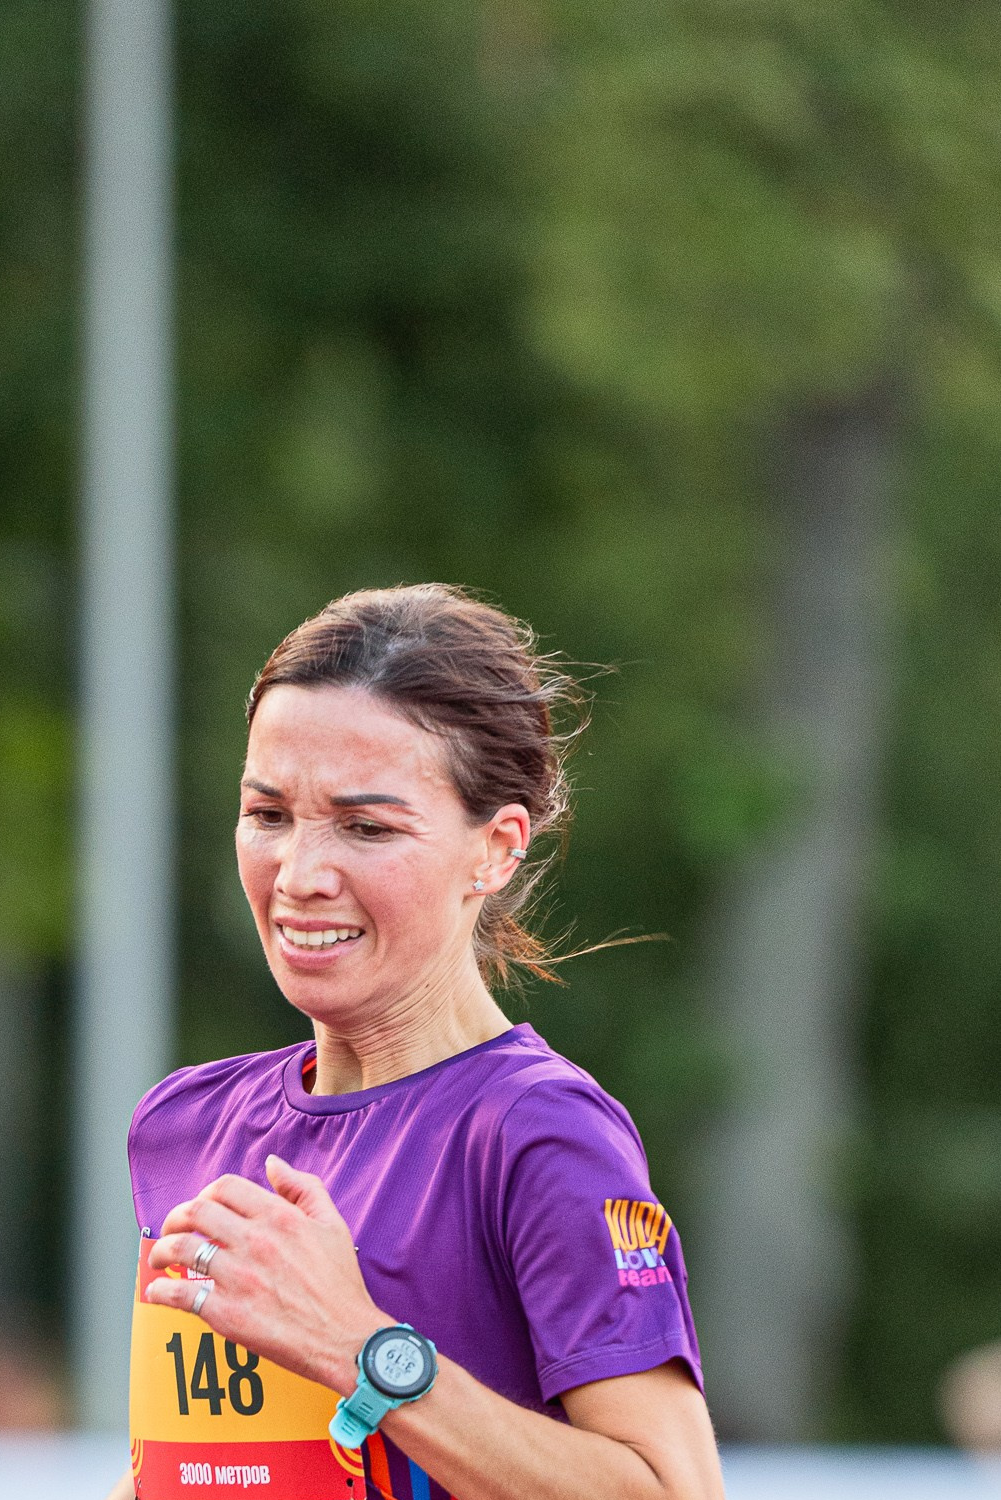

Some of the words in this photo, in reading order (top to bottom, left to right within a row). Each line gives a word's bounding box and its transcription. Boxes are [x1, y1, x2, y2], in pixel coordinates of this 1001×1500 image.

[614, 1247, 666, 1269] LOV
[165, 1332, 265, 1416] 148
[179, 1462, 213, 1485] 3000
[214, 1465, 271, 1489] метров
